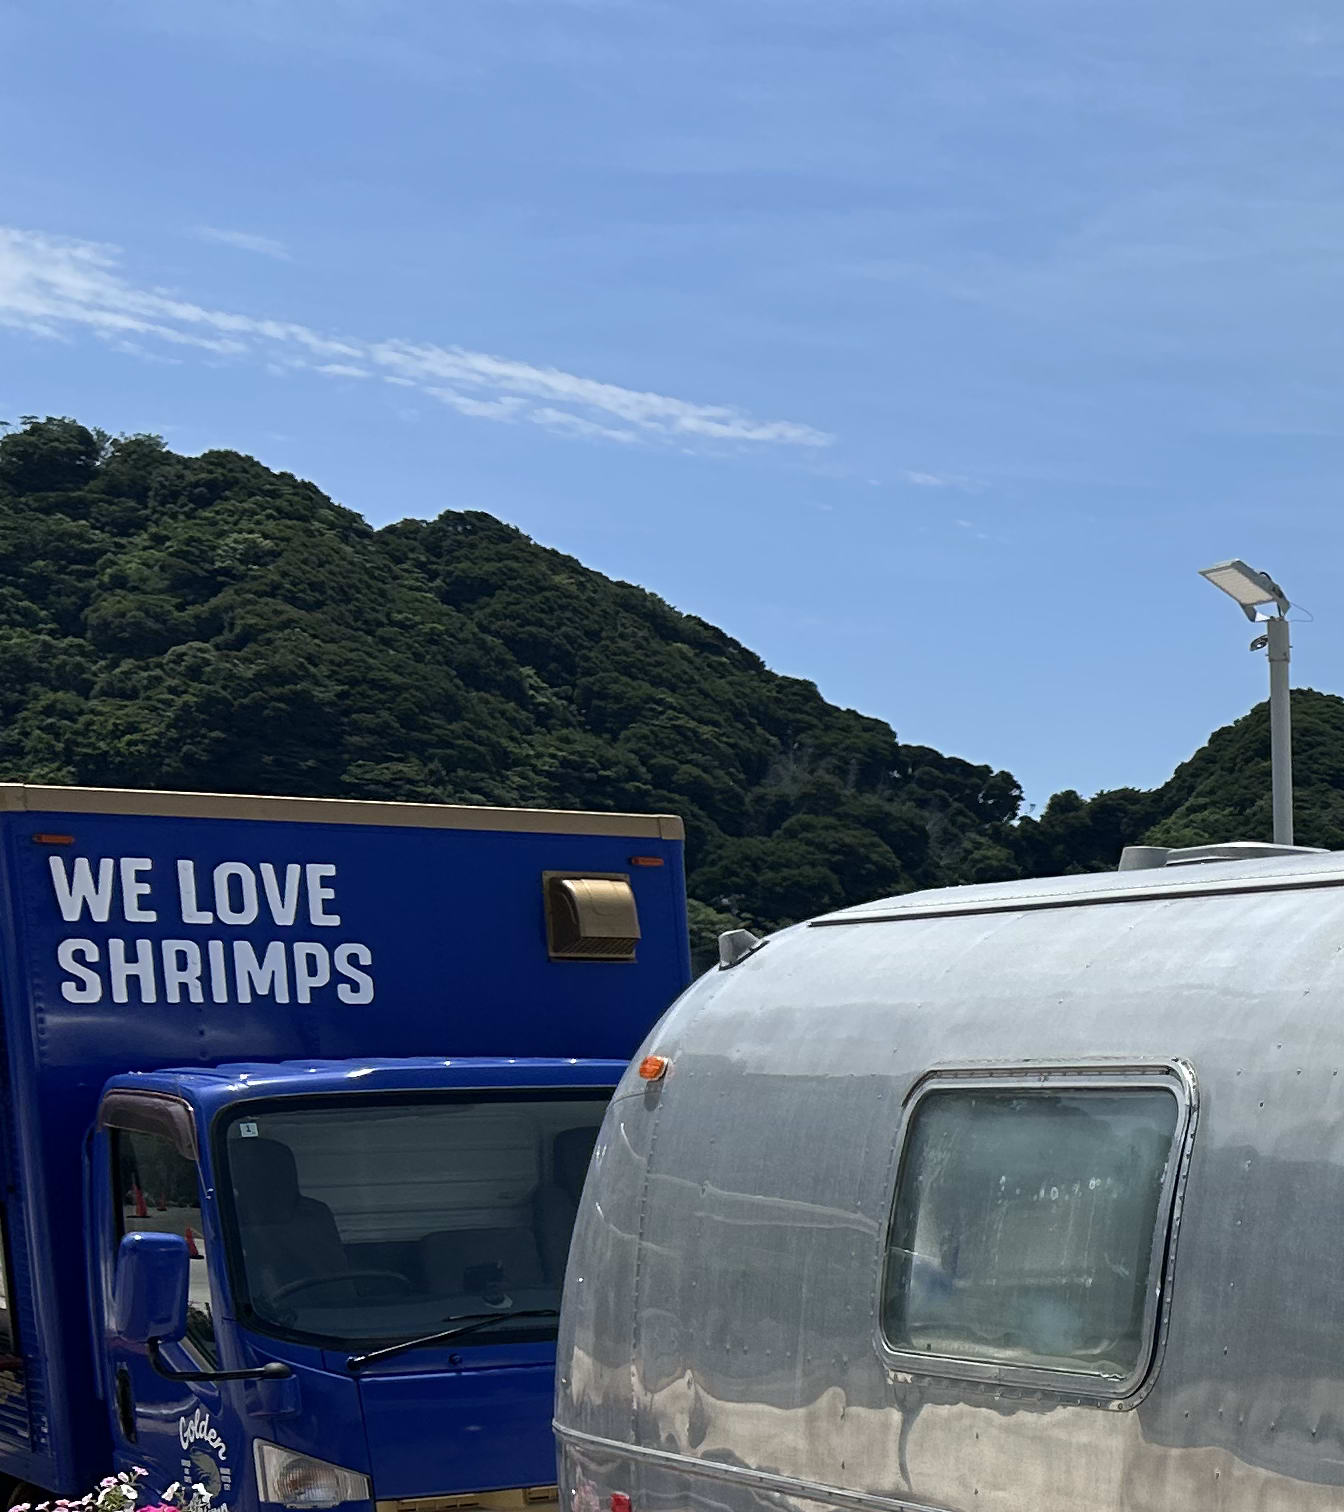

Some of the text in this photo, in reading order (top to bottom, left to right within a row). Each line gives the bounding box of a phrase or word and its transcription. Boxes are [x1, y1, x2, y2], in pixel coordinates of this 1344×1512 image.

[49, 857, 342, 927] WE LOVE
[57, 938, 374, 1004] SHRIMPS
[179, 1408, 227, 1460] Golden
